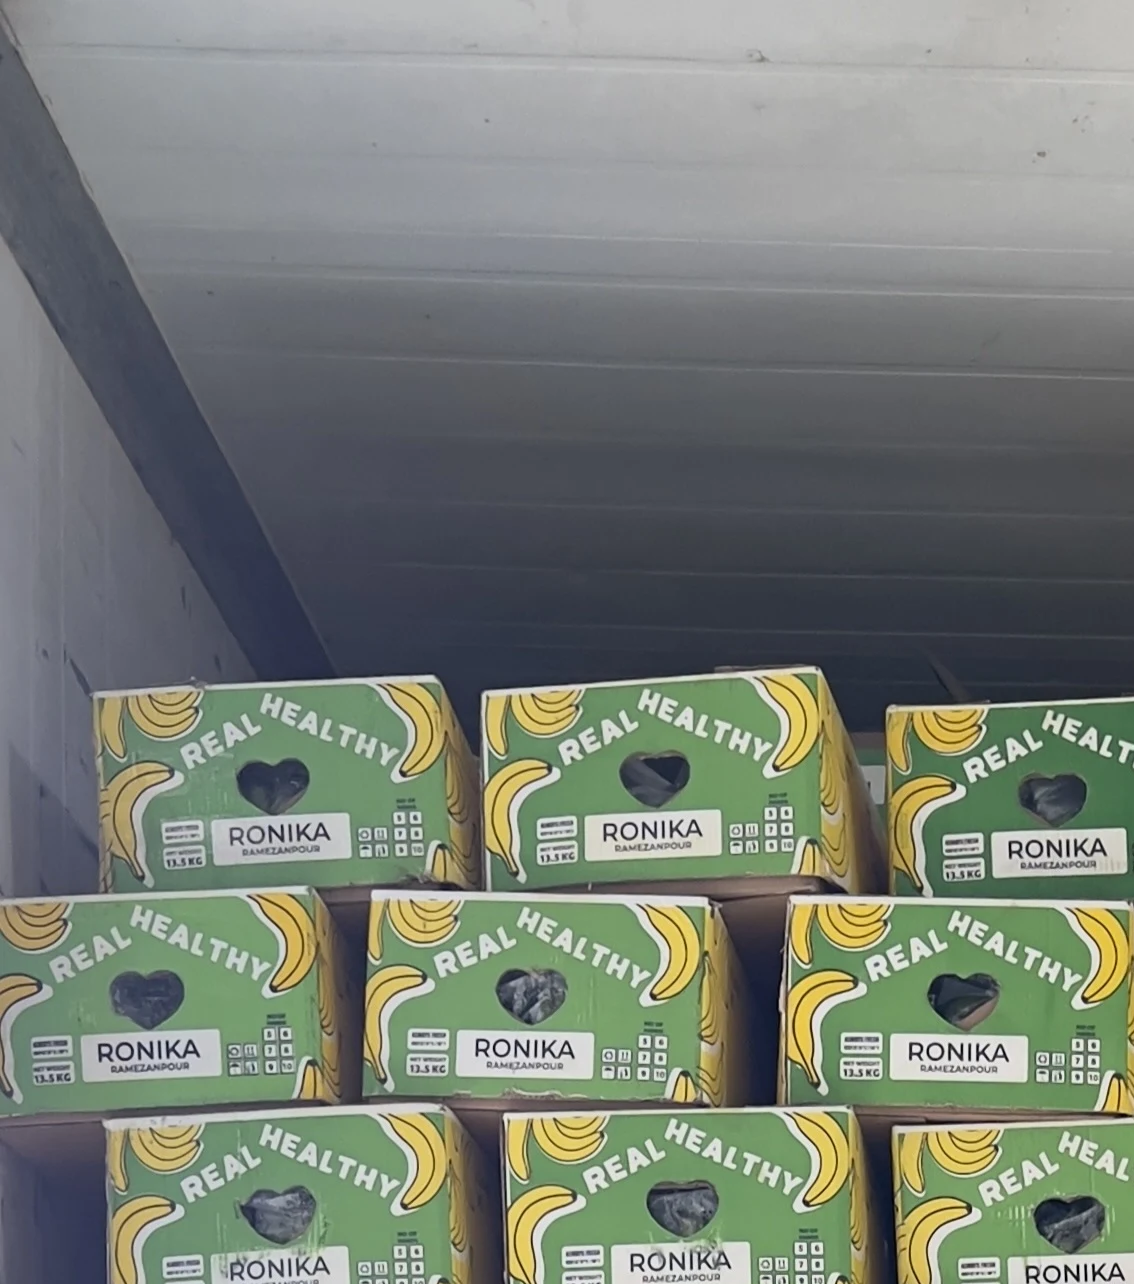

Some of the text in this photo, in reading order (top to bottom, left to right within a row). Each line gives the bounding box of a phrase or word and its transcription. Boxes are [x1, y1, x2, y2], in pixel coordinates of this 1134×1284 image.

[178, 692, 400, 770] REAL HEALTHY
[557, 689, 774, 766] REAL HEALTHY
[961, 729, 1043, 784] REAL
[229, 821, 332, 848] RONIKA
[602, 817, 703, 844] RONIKA
[614, 840, 693, 855] RAMEZANPOUR
[1007, 836, 1108, 862] RONIKA
[48, 904, 271, 984] REAL HEALTHY
[433, 906, 651, 990] REAL HEALTHY
[864, 910, 1083, 993] REAL HEALTHY
[97, 1037, 201, 1065] RONIKA
[474, 1037, 575, 1061] RONIKA
[908, 1041, 1009, 1064] RONIKA
[110, 1060, 191, 1075] RAMEZANPOUR
[863, 1066, 881, 1079] KG
[920, 1064, 999, 1075] RAMEZANPOUR
[179, 1124, 401, 1204] REAL HEALTHY
[582, 1118, 804, 1197] REAL HEALTHY
[977, 1151, 1060, 1207] REAL
[228, 1255, 331, 1283] RONIKA
[629, 1249, 732, 1274] RONIKA
[642, 1272, 722, 1284] RAMEZANPOUR
